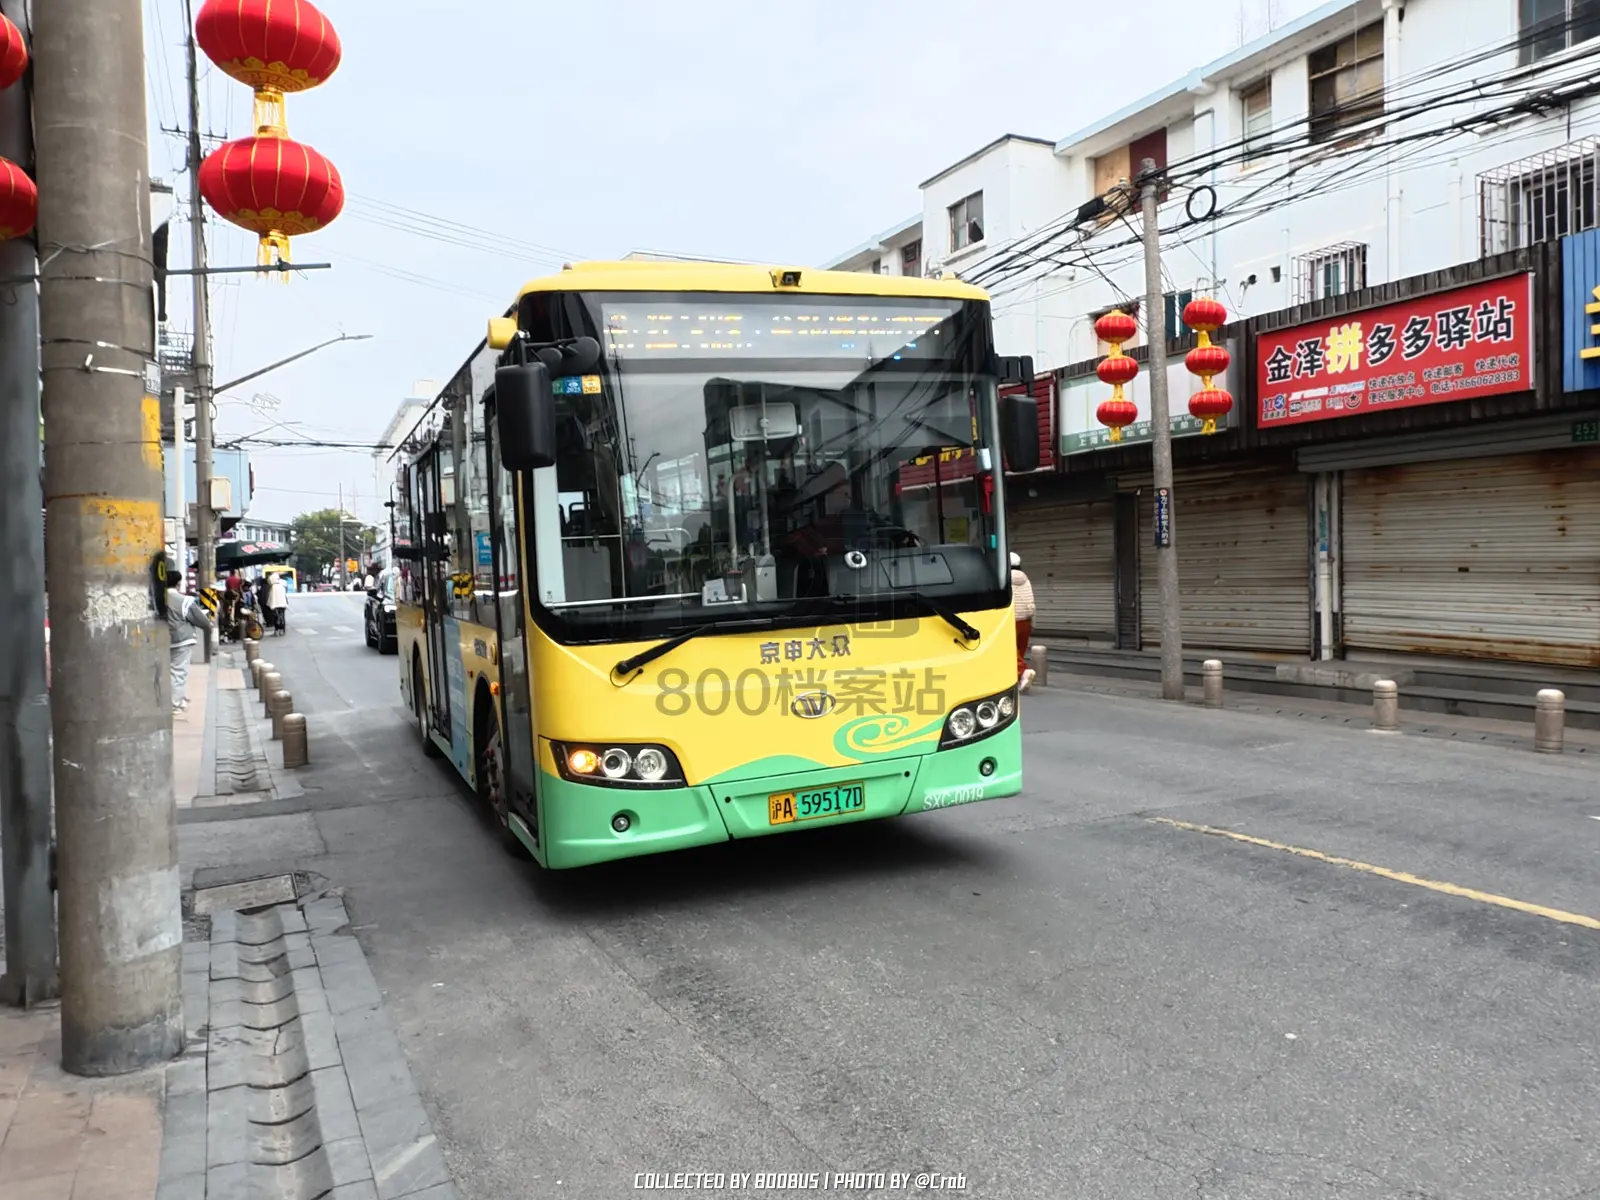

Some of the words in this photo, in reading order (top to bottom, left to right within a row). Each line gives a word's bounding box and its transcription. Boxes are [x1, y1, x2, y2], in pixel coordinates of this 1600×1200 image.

[1265, 296, 1516, 385] 金泽拼多多驿站
[1423, 363, 1464, 381] 快递邮寄
[1475, 353, 1520, 372] 快递代收
[1368, 386, 1425, 404] 便民服务中心
[1576, 422, 1597, 435] 253
[759, 634, 852, 665] 京申大众
[772, 797, 794, 820] 沪A
[801, 786, 863, 815] 59517D
[922, 786, 984, 811] SXC-0019
